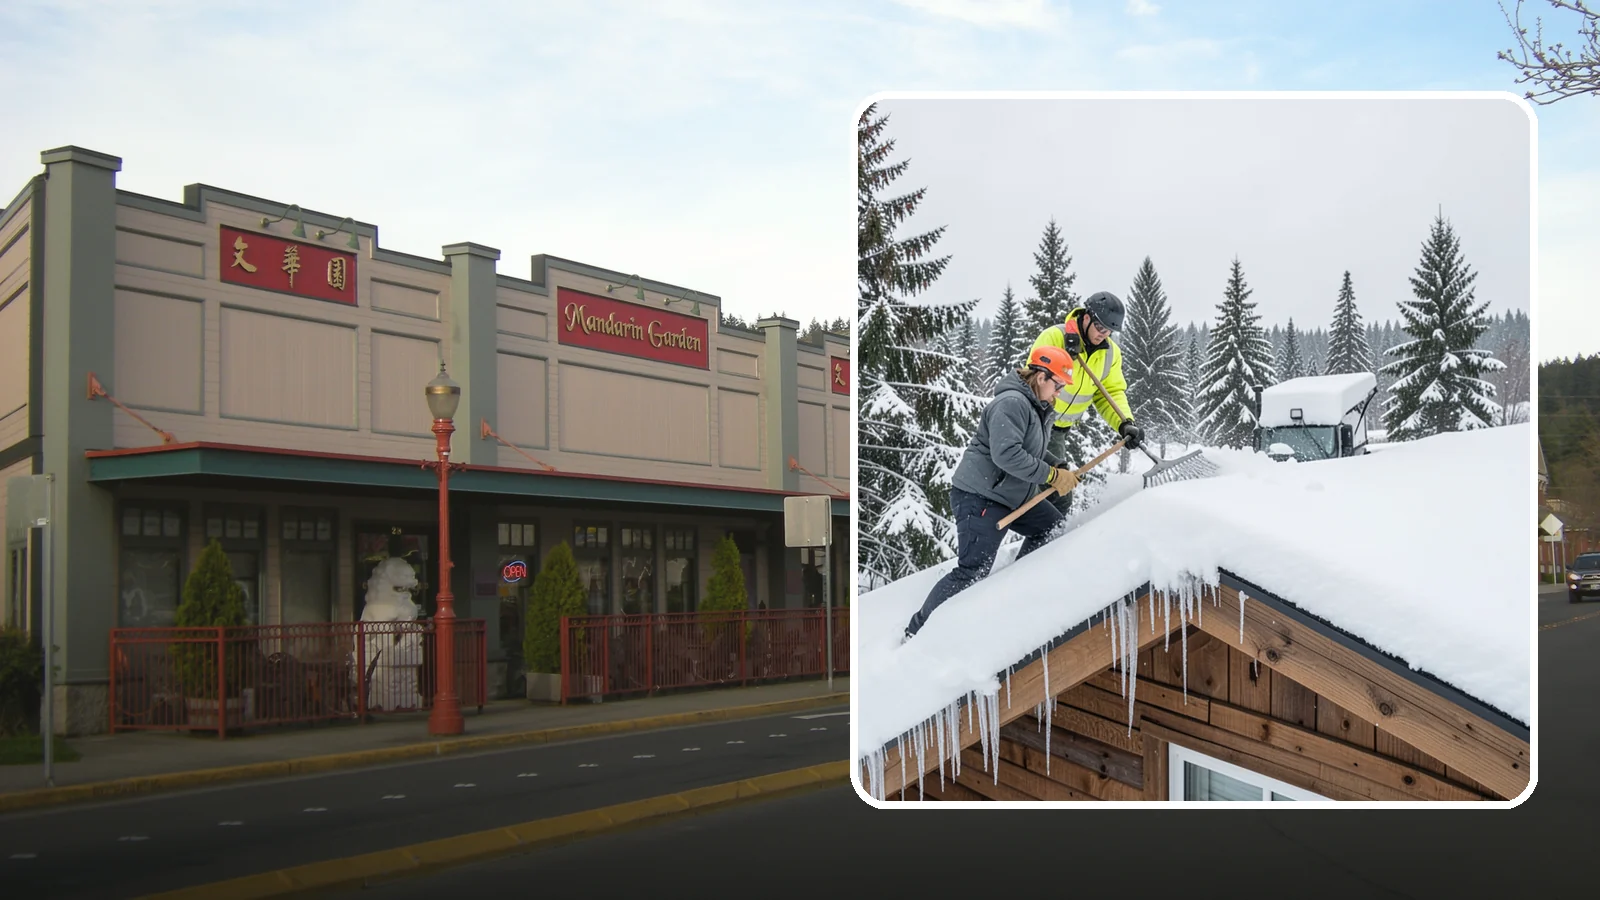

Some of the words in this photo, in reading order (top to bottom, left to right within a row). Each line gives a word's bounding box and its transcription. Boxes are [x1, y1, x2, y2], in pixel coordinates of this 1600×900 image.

[231, 235, 346, 290] 文華園
[564, 302, 644, 341] Mandarin
[648, 320, 701, 352] Garden
[503, 565, 527, 579] OPEN
